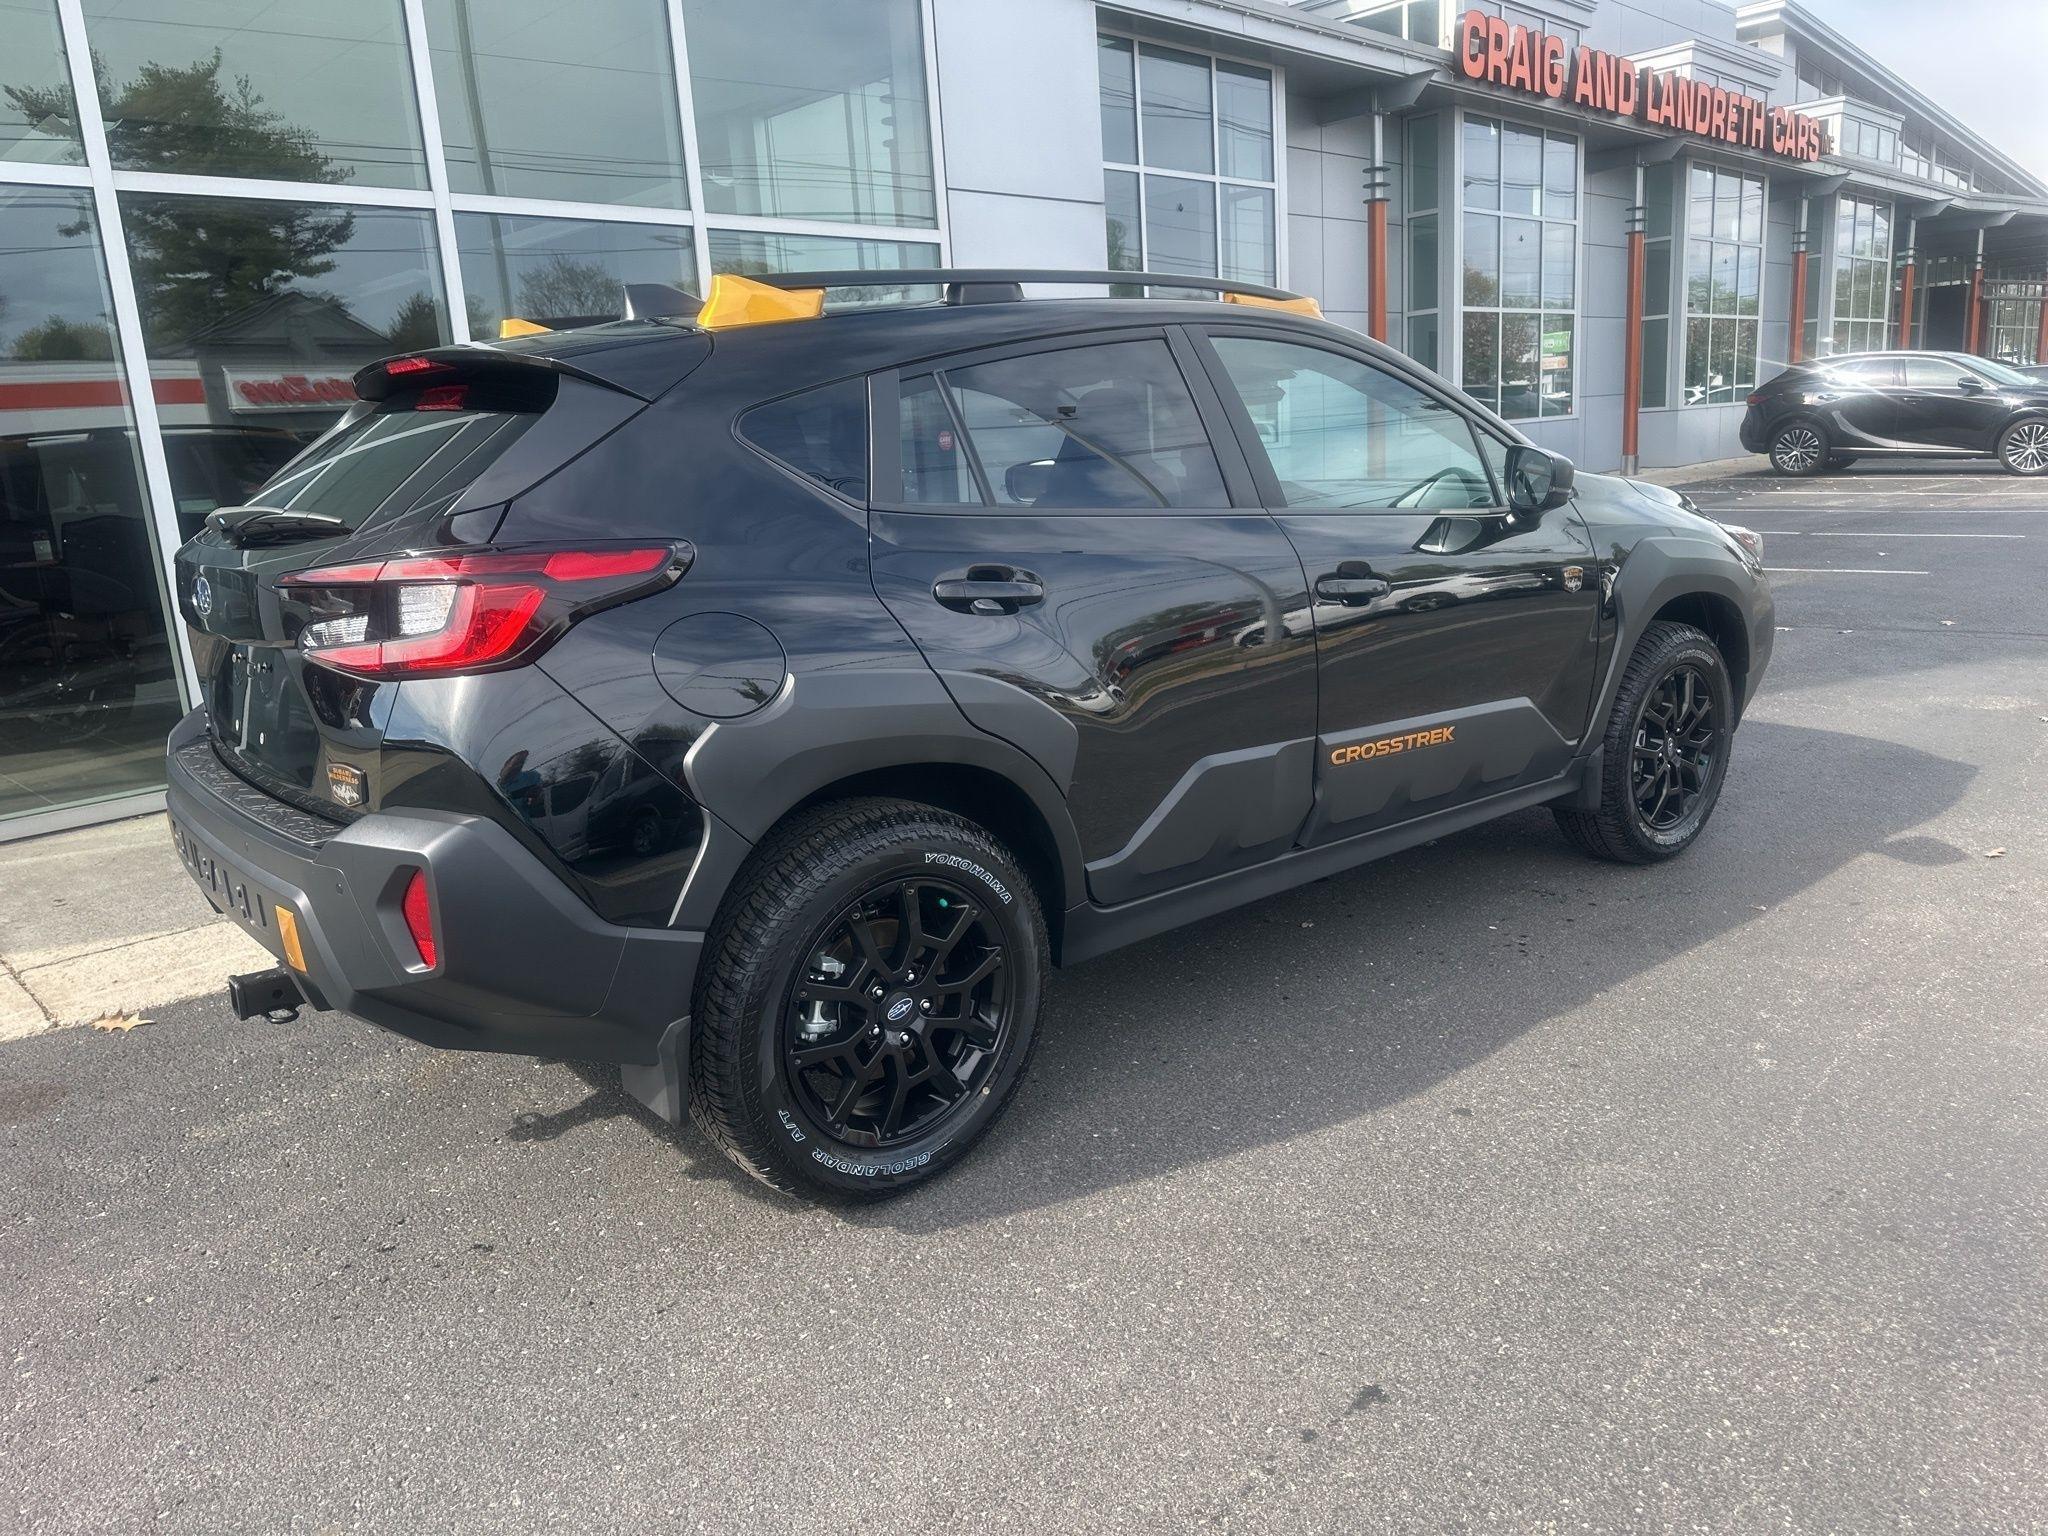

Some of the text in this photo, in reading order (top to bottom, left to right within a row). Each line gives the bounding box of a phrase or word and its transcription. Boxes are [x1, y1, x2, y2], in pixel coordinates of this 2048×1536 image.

[1462, 9, 1564, 98] CRAIG
[1575, 45, 1636, 116] AND
[1647, 66, 1766, 149] LANDRETH
[1772, 106, 1820, 162] CARS
[1330, 725, 1456, 765] CROSSTREK
[924, 853, 1013, 905] YOKOHAMA
[778, 1109, 806, 1142] A/T
[811, 1147, 931, 1177] GEOLANDAR
